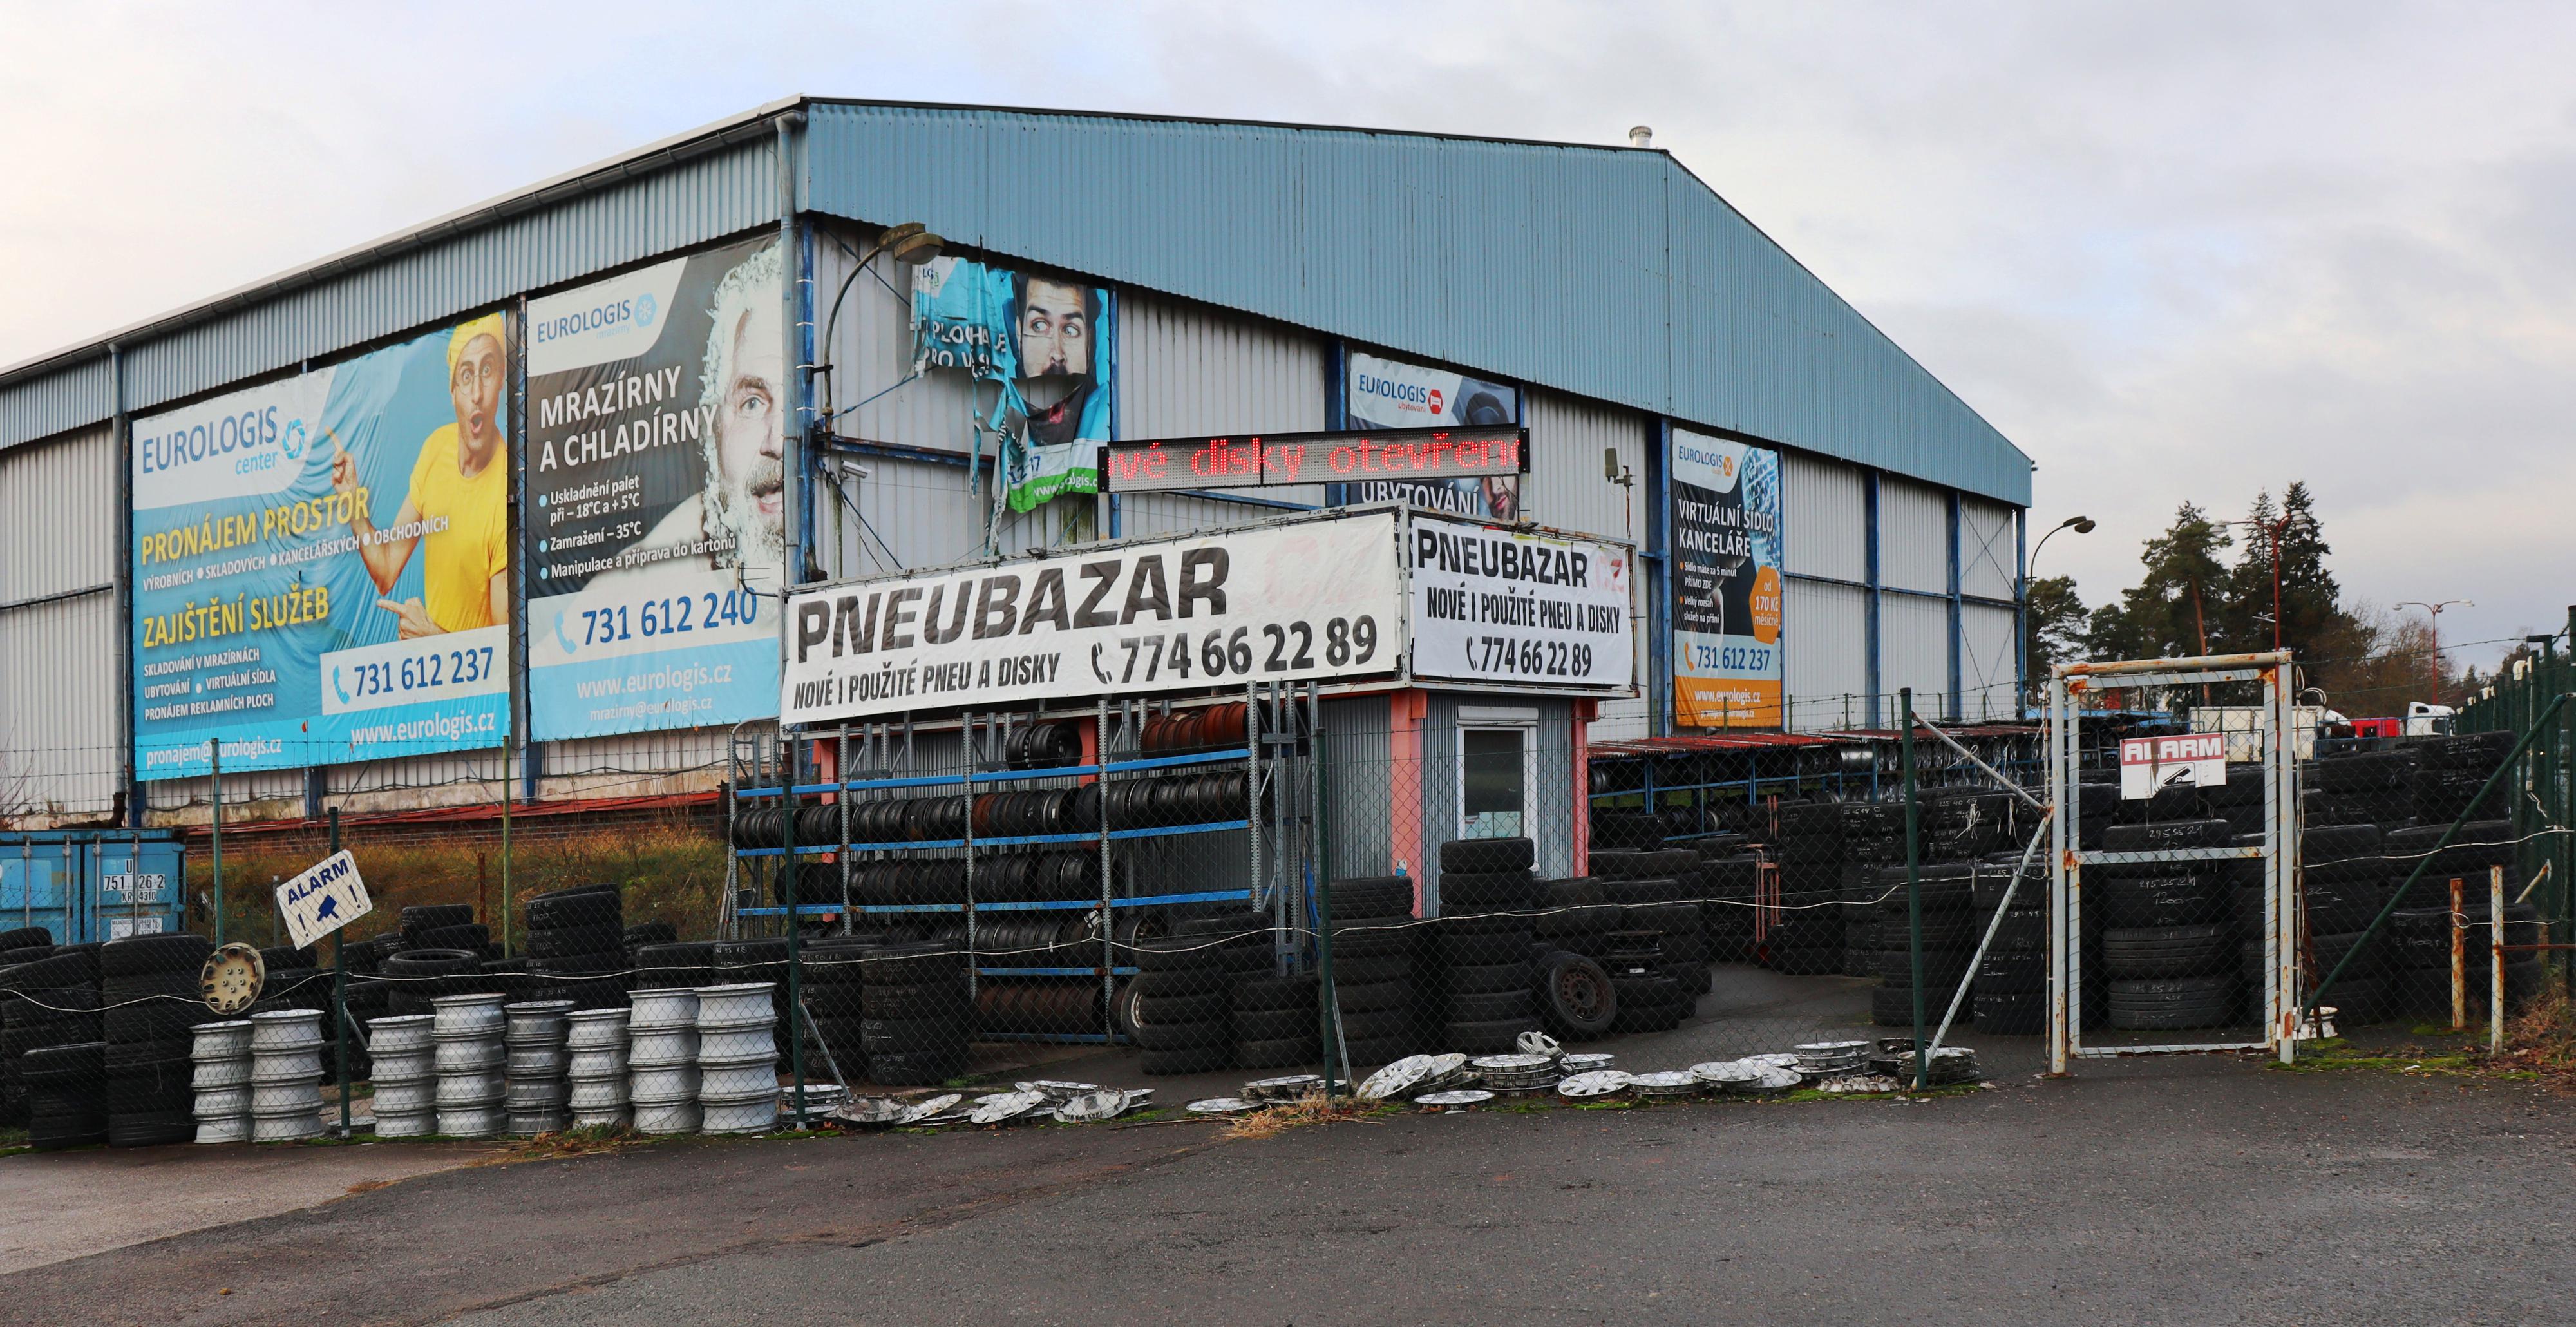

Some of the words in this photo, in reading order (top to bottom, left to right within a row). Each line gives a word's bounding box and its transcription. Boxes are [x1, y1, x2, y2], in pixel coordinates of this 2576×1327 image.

[538, 300, 631, 343] EUROLOGIS
[541, 366, 681, 429] MRAZÍRNY
[1359, 374, 1426, 403] EUROLOGIS
[142, 405, 278, 473] EUROLOGIS
[540, 441, 558, 472] A
[564, 404, 717, 468] CHLADÍRNY
[235, 449, 278, 475] center
[1191, 437, 1303, 481] disky
[1679, 446, 1723, 468] EUROLOGIS
[551, 479, 610, 506] Uskladnění
[612, 475, 639, 496] palet
[1361, 482, 1479, 515] UBYTOVÁNÍ
[142, 513, 256, 565] PRONÁJEM
[263, 487, 370, 541] PROSTOR
[550, 508, 565, 526] při
[603, 504, 610, 513] a
[1678, 499, 1741, 527] VIRTUÁLNÍ
[142, 568, 193, 592] VÝROBNÍCH
[205, 556, 265, 580] SKLADOVÝCH
[279, 534, 360, 566] KANCELÁŘSKÝCH
[374, 515, 449, 546] OBCHODNÍCH
[550, 527, 605, 551] Zamražení
[551, 555, 613, 578] Manipulace
[616, 557, 622, 567] a
[625, 544, 670, 571] příprava
[673, 544, 688, 557] do
[690, 532, 736, 555] kartonů
[1679, 527, 1750, 557] KANCELÁŘE
[1417, 528, 1588, 588] PNEUBAZAR
[1685, 561, 1696, 573] Sídlo
[1697, 564, 1709, 574] máte
[1716, 566, 1720, 575] 5
[1721, 567, 1737, 577] minut
[1702, 579, 1712, 589] ZDE
[1764, 582, 1772, 592] od
[143, 591, 244, 647] ZAJIŠTĚNÍ
[251, 582, 329, 630] SLUŽEB
[583, 604, 631, 645] 731
[641, 595, 692, 636] 612
[703, 587, 757, 629] 240
[797, 546, 1230, 664] PNEUBAZAR
[1427, 580, 1466, 620] NOVÉ
[1472, 592, 1475, 622] I
[1481, 586, 1536, 627] POUŽITÉ
[1540, 599, 1572, 630] PNEU
[1577, 603, 1584, 631] A
[1587, 604, 1620, 634] DISKY
[1684, 595, 1697, 608] Velký
[1698, 598, 1713, 607] rozsah
[1756, 595, 1769, 611] 170
[1770, 596, 1779, 612] Kč
[1684, 611, 1699, 621] služeb
[1707, 613, 1719, 625] přání
[144, 653, 194, 677] SKLADOVÁNÍ
[196, 657, 203, 670] V
[204, 647, 260, 668] MRAZÍRNÁCH
[1120, 632, 1192, 684] 774
[1202, 627, 1253, 678] 66
[1264, 622, 1315, 672] 22
[1325, 615, 1377, 666] 89
[1481, 636, 1516, 673] 774
[1520, 640, 1542, 674] 66
[1547, 641, 1568, 675] 22
[1571, 642, 1592, 677] 89
[1697, 645, 1718, 669] 731
[1723, 647, 1745, 669] 612
[1749, 649, 1770, 671] 237
[144, 680, 190, 699] UBYTOVÁNÍ
[205, 672, 250, 691] VIRTUÁLNÍ
[252, 669, 276, 684] SÍDLA
[355, 662, 393, 697] 731
[401, 654, 444, 690] 612
[451, 646, 493, 684] 237
[576, 661, 732, 699] www.eurologis.cz
[793, 669, 834, 710] NOVÉ
[838, 676, 844, 705] I
[848, 659, 918, 702] POUŽITÉ
[922, 662, 971, 693] PNEU
[977, 660, 990, 687] A
[997, 651, 1061, 687] DISKY
[144, 702, 189, 721] PRONÁJEM
[190, 696, 245, 716] REKLAMNÍCH
[246, 692, 274, 708] PLOCH
[1694, 687, 1761, 705] www.eurologis.cz
[351, 709, 495, 747] www.eurologis.cz
[146, 736, 283, 769] pronajem@urologis.cz
[2124, 738, 2221, 761] ALARM
[126, 859, 133, 873] U
[288, 858, 350, 906] ALARM
[104, 875, 124, 890] 751
